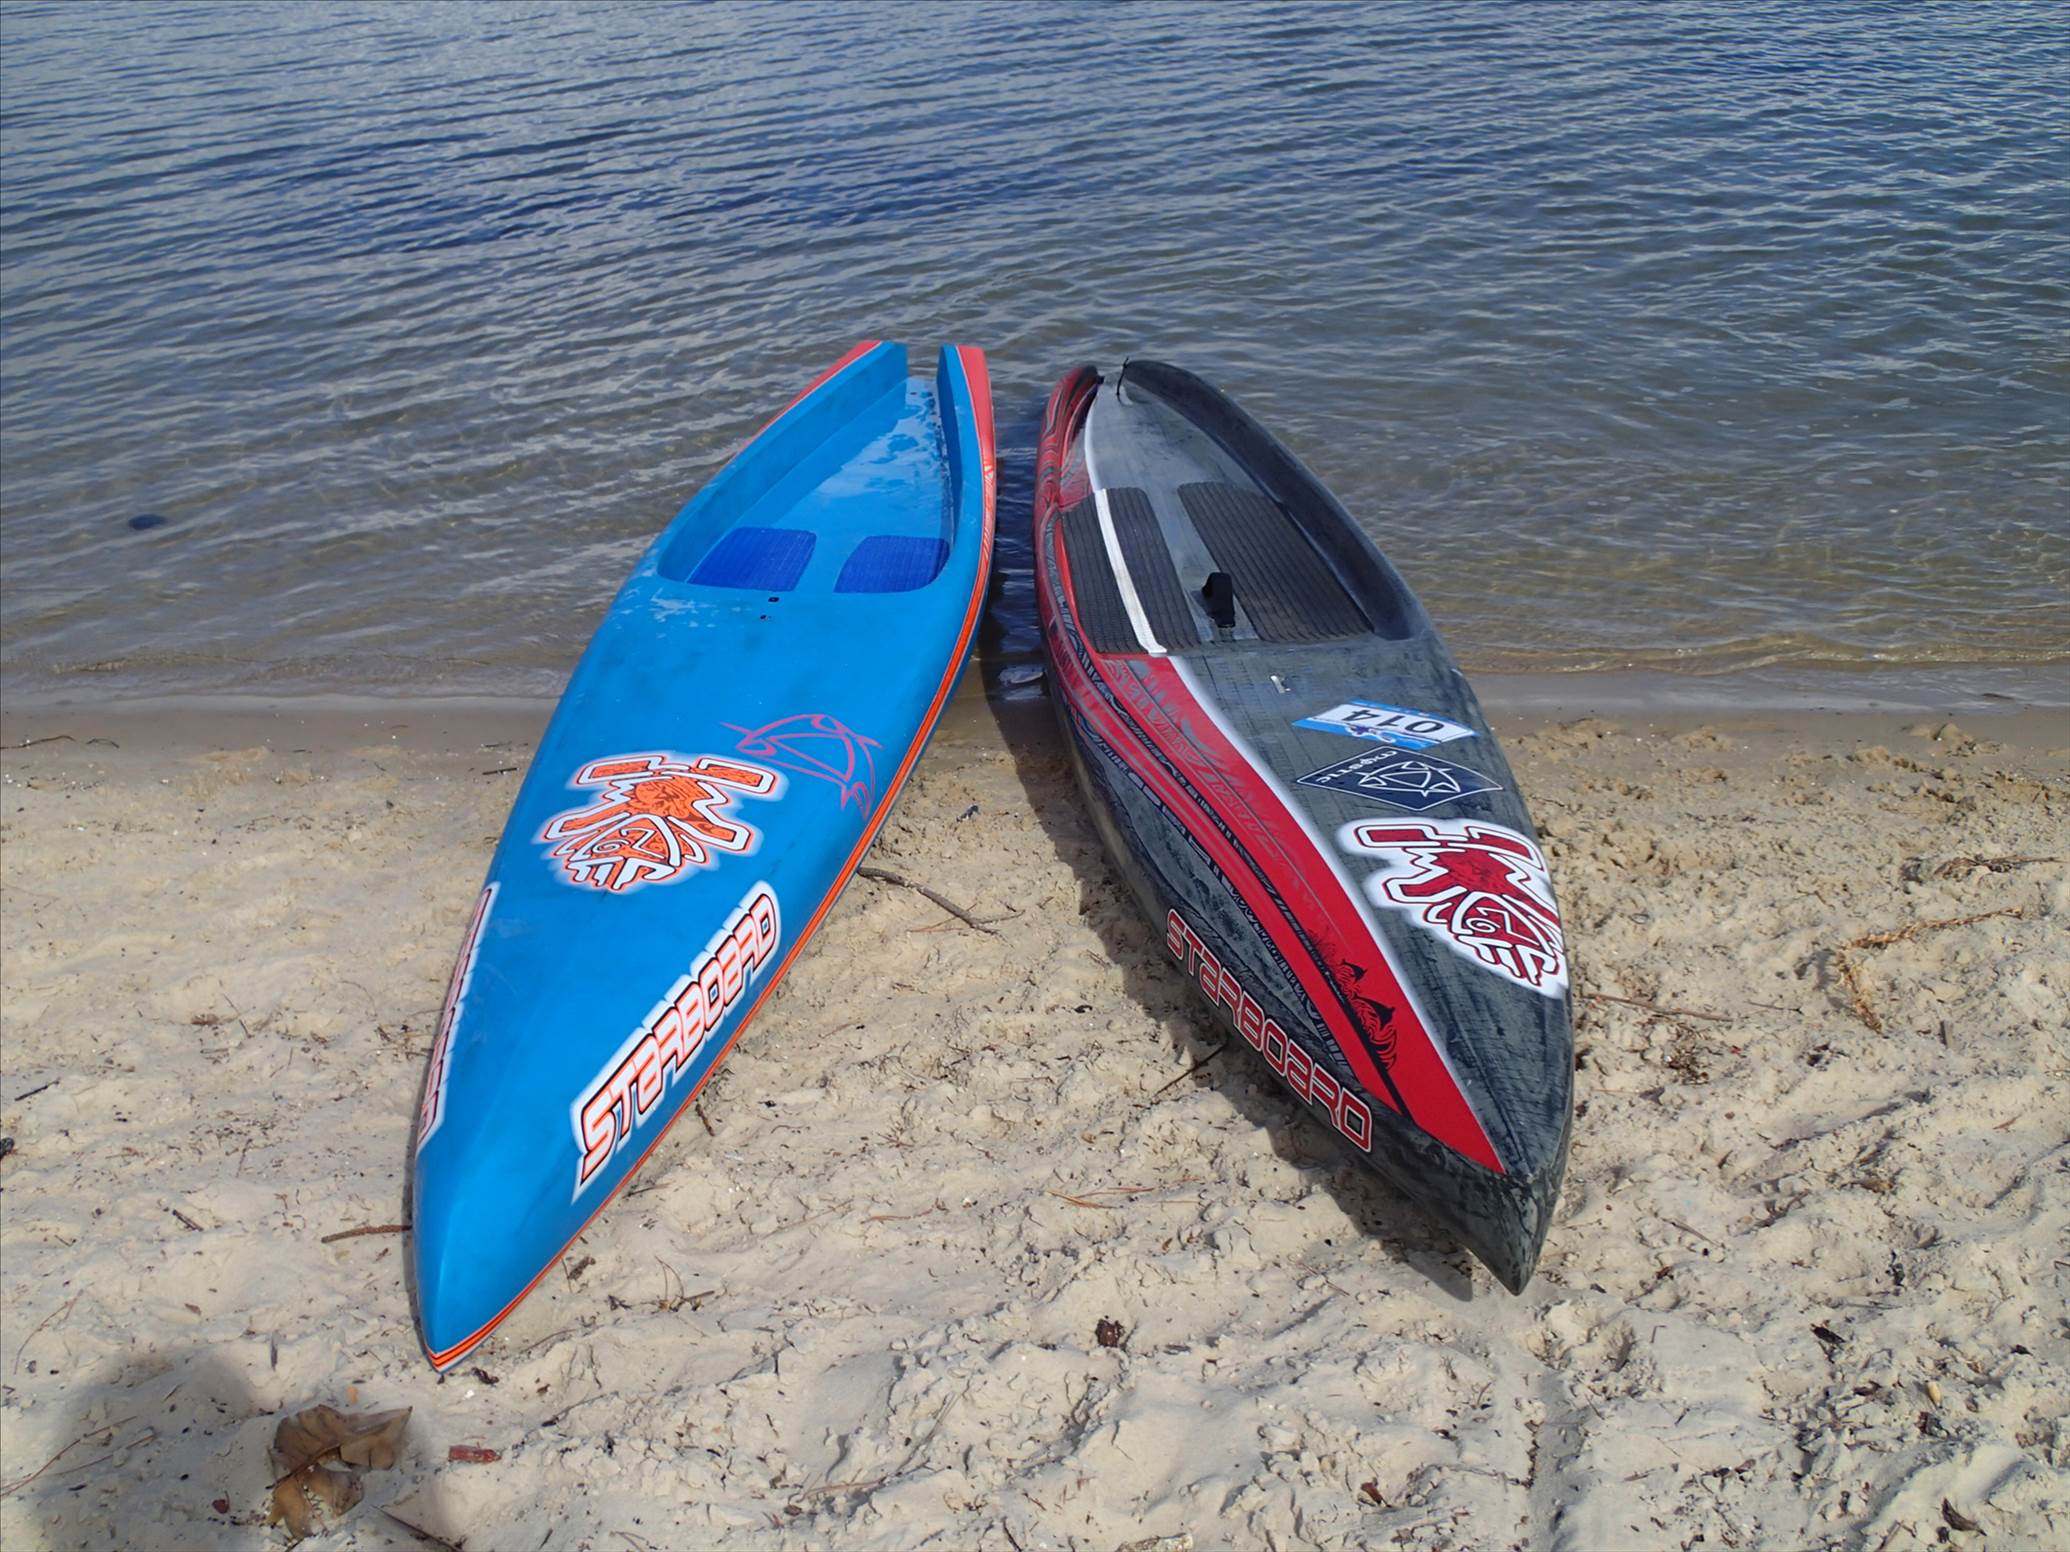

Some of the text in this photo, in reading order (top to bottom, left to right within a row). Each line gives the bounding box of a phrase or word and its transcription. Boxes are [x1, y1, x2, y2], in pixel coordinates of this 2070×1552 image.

[1341, 709, 1444, 733] 014
[577, 892, 778, 1185] STARBOARD
[1167, 908, 1373, 1152] STARBOARD
